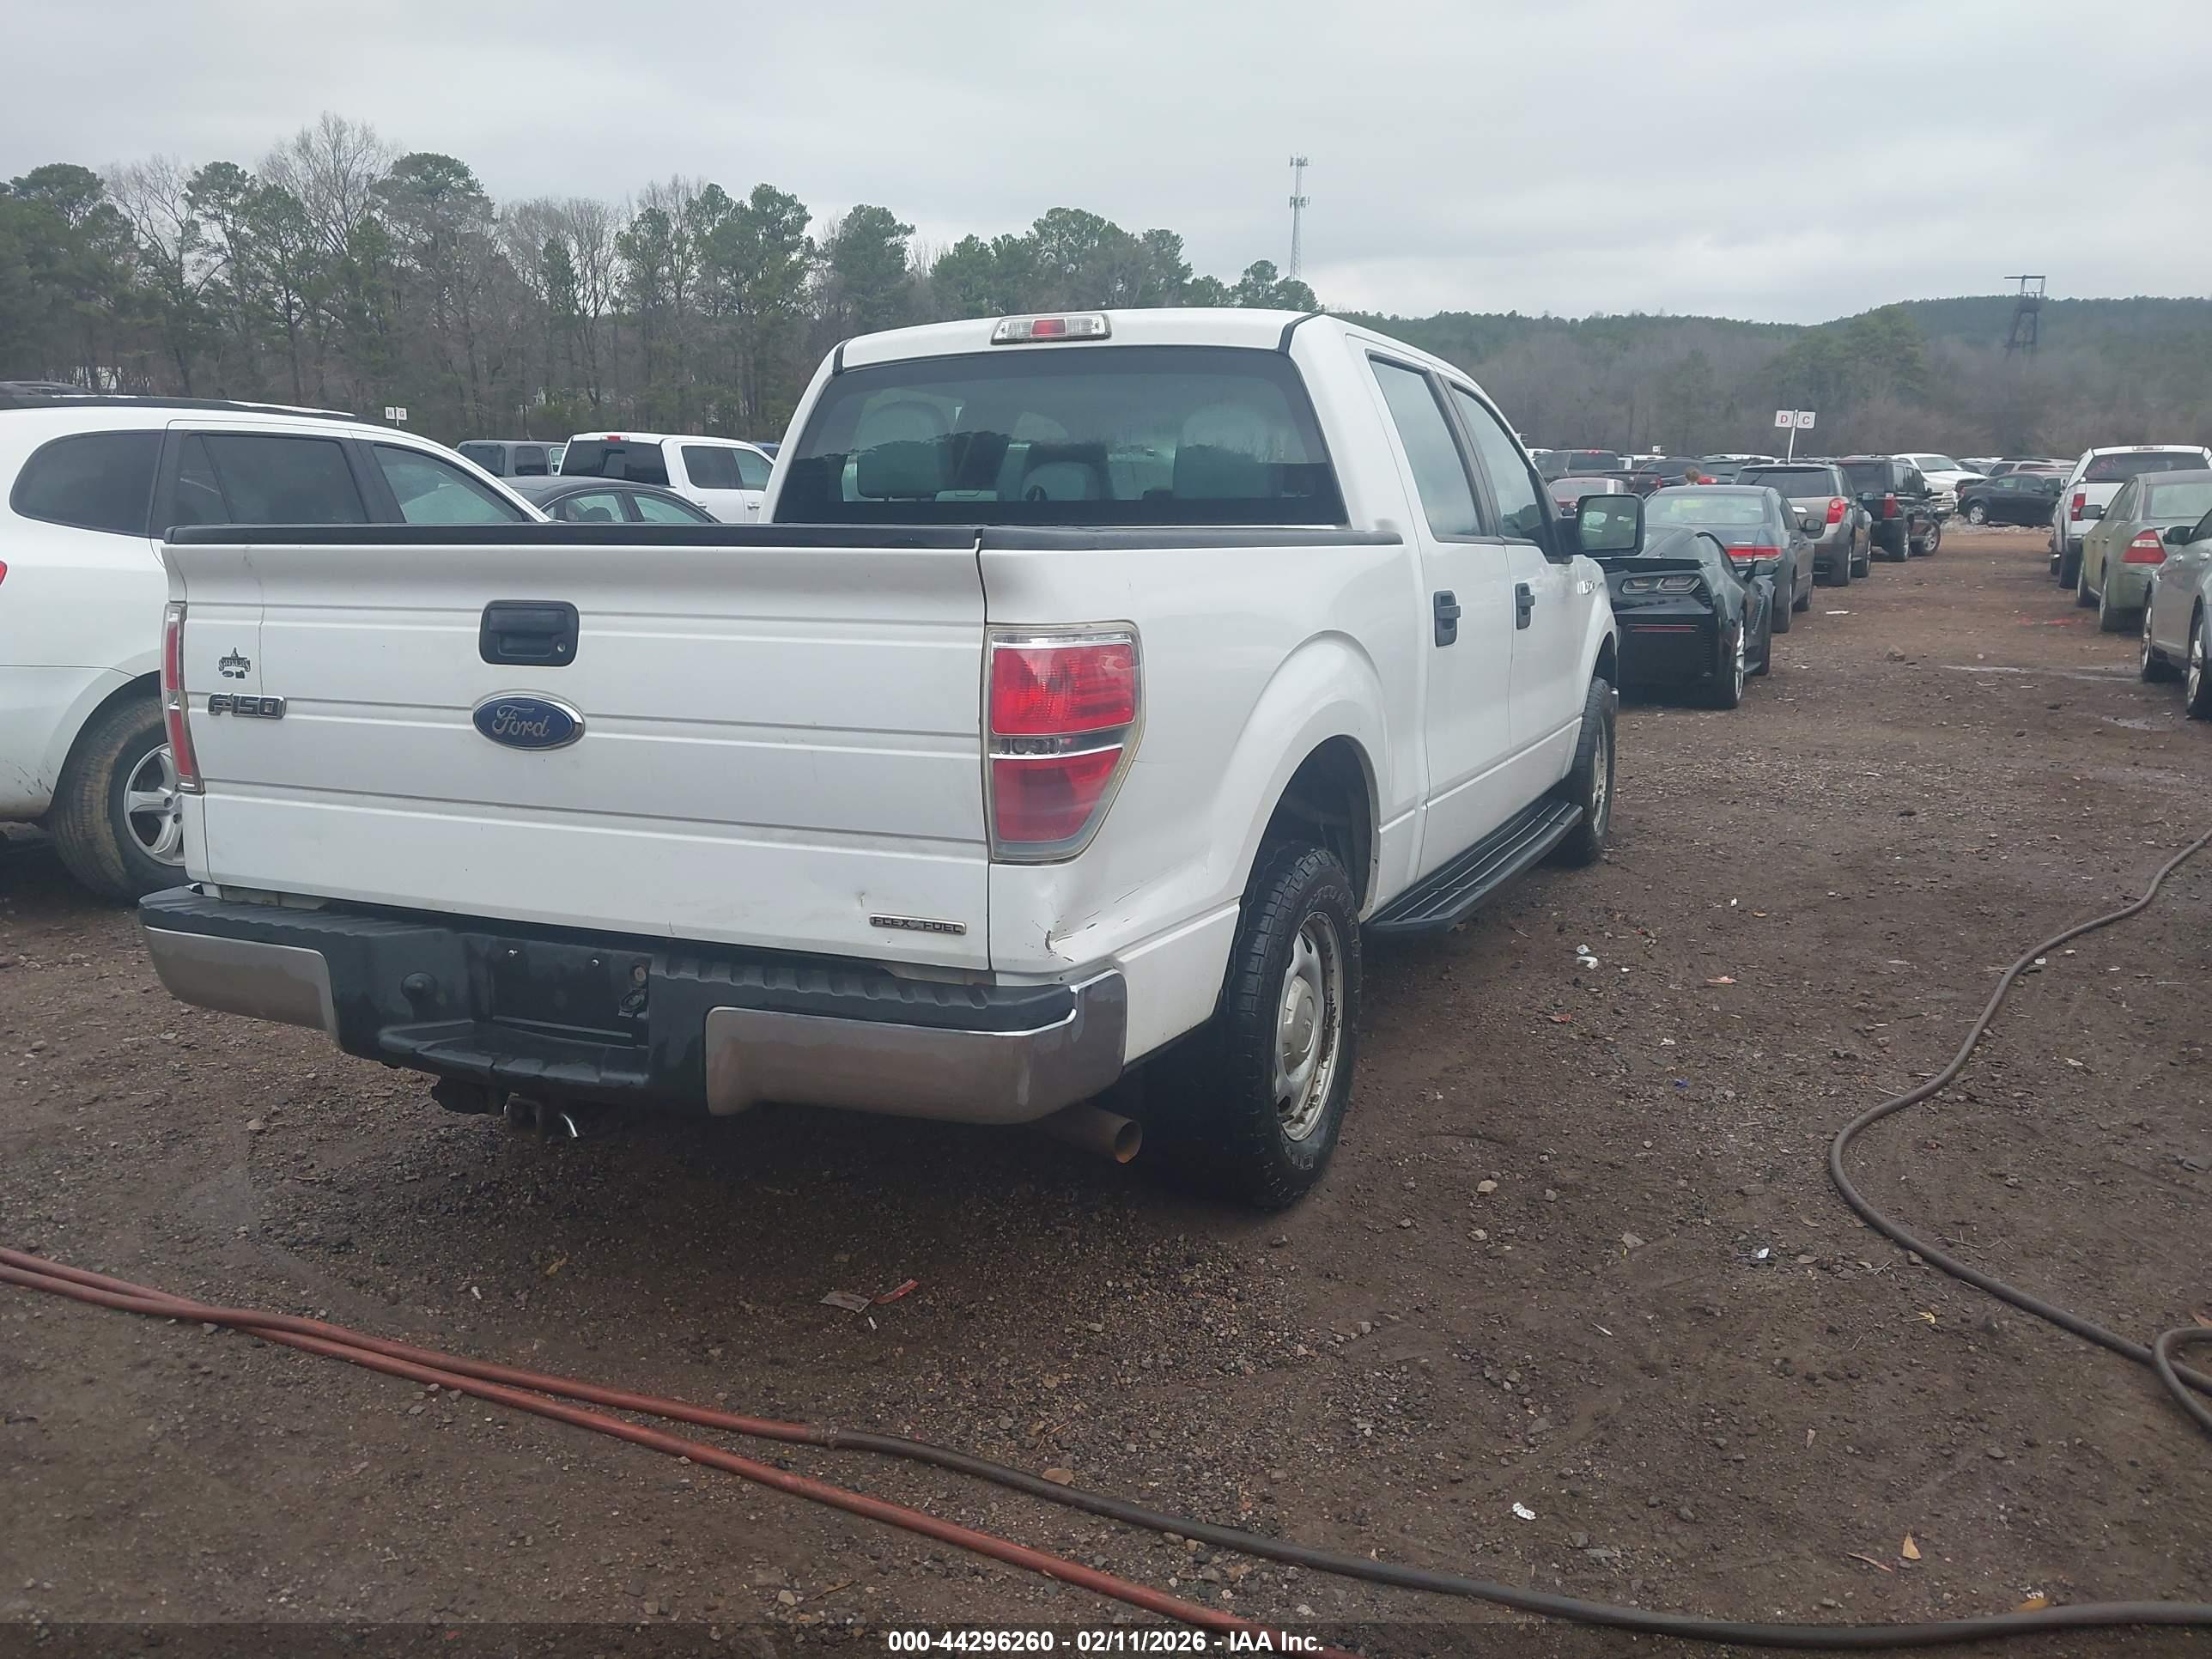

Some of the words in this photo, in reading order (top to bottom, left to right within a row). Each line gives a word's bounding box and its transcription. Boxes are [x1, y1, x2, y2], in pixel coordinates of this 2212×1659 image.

[1780, 415, 1788, 423] D
[1802, 416, 1810, 424] C
[208, 693, 286, 720] F-150
[492, 705, 550, 737] Ford
[872, 916, 911, 928] FLEX
[923, 921, 962, 933] FUEL
